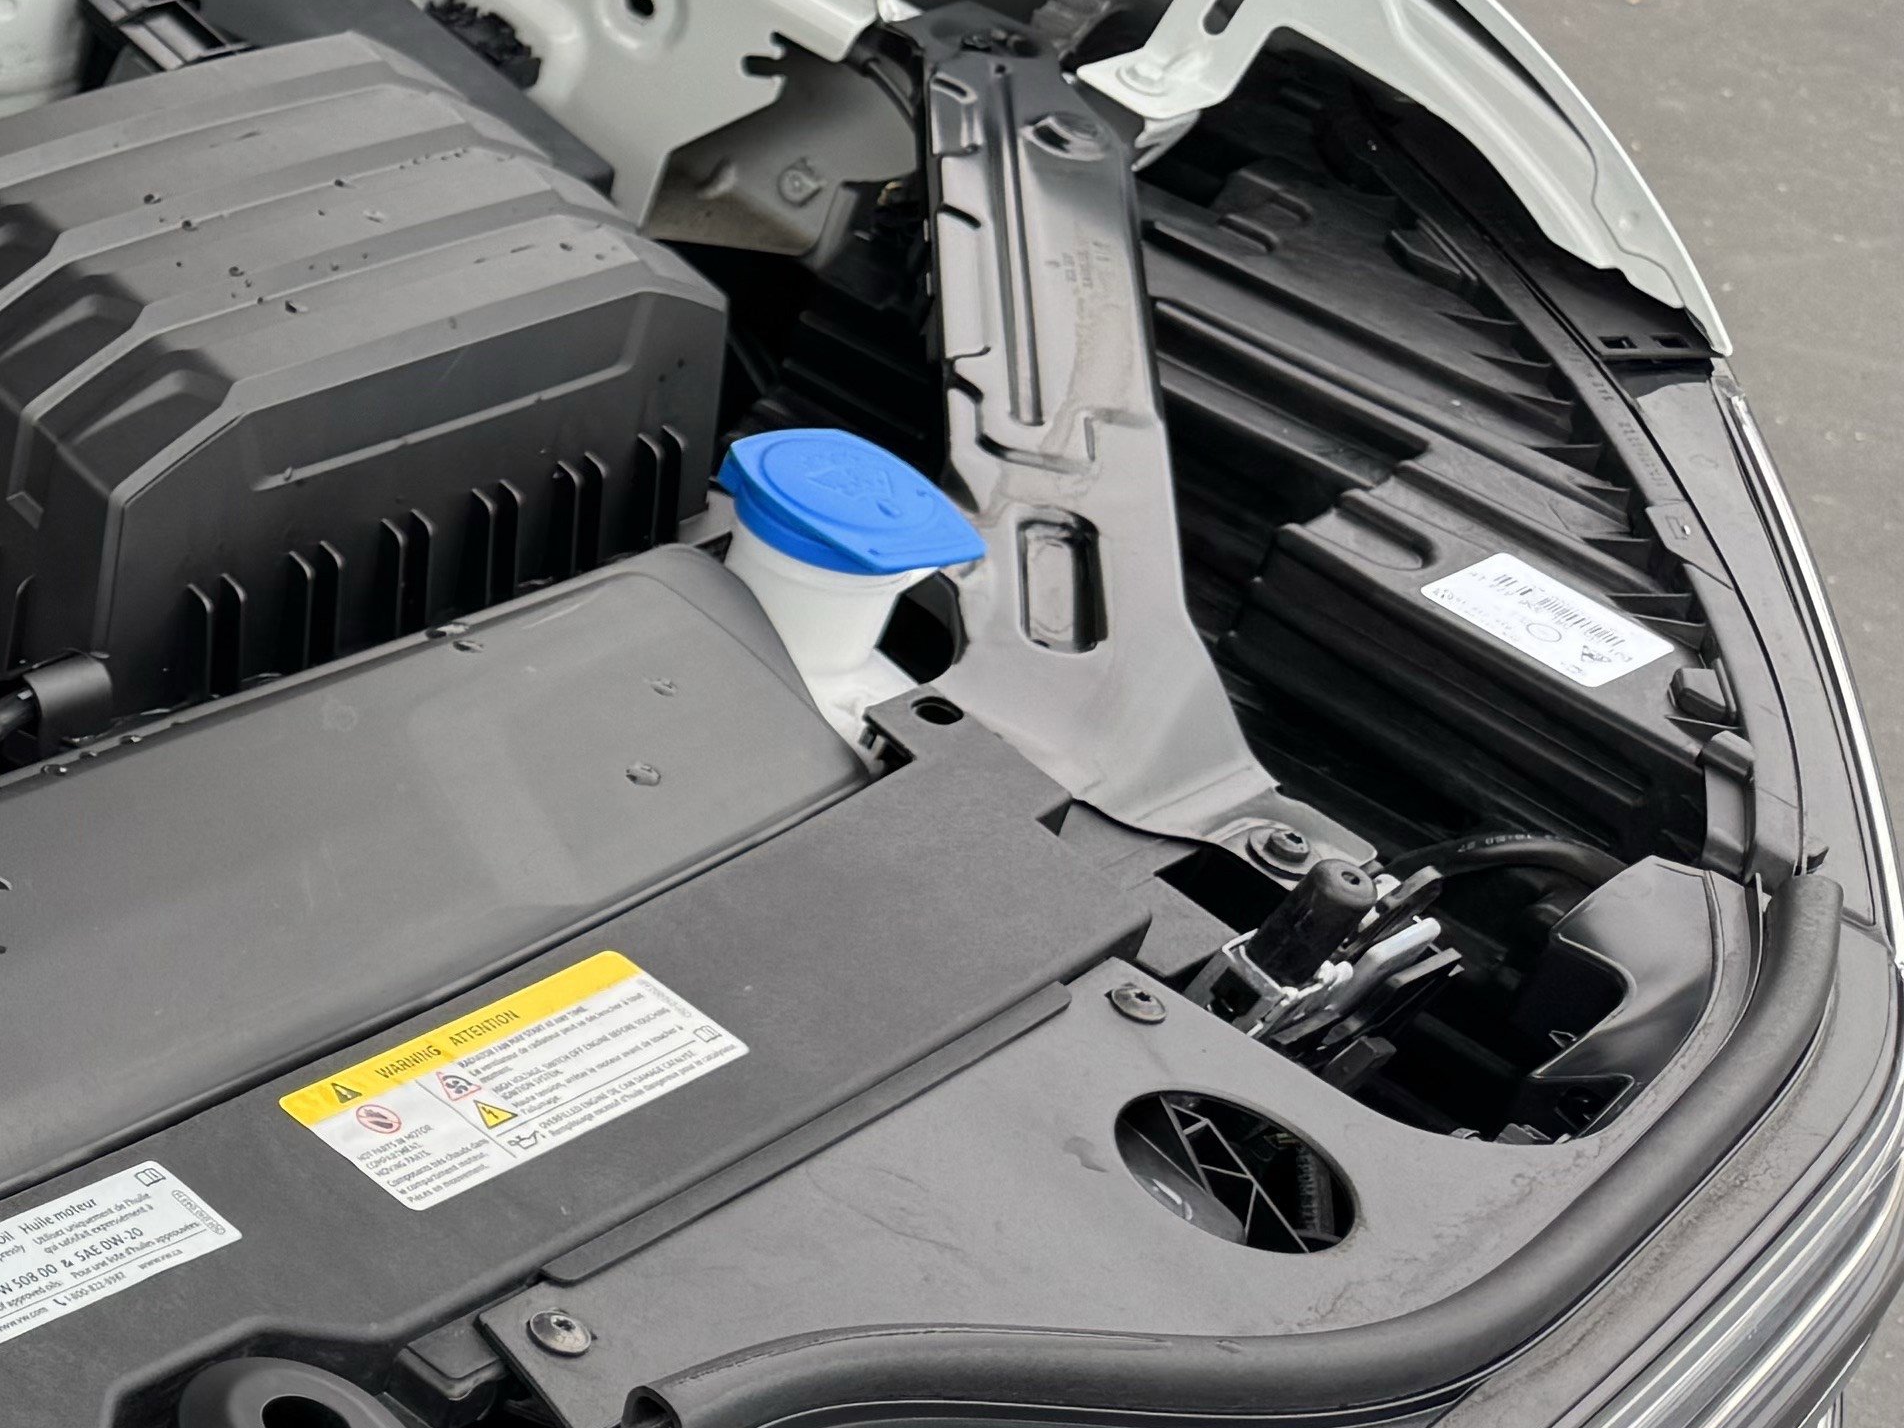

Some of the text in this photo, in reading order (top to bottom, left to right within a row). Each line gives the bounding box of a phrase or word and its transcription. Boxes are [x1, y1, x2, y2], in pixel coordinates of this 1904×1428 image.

[374, 1009, 520, 1079] WARNING ATTENTION
[16, 1213, 55, 1234] Huile
[50, 1196, 99, 1221] moteur
[10, 1271, 39, 1288] 508
[35, 1263, 59, 1277] 00
[72, 1244, 102, 1261] SAE
[98, 1226, 145, 1250] 0W-20
